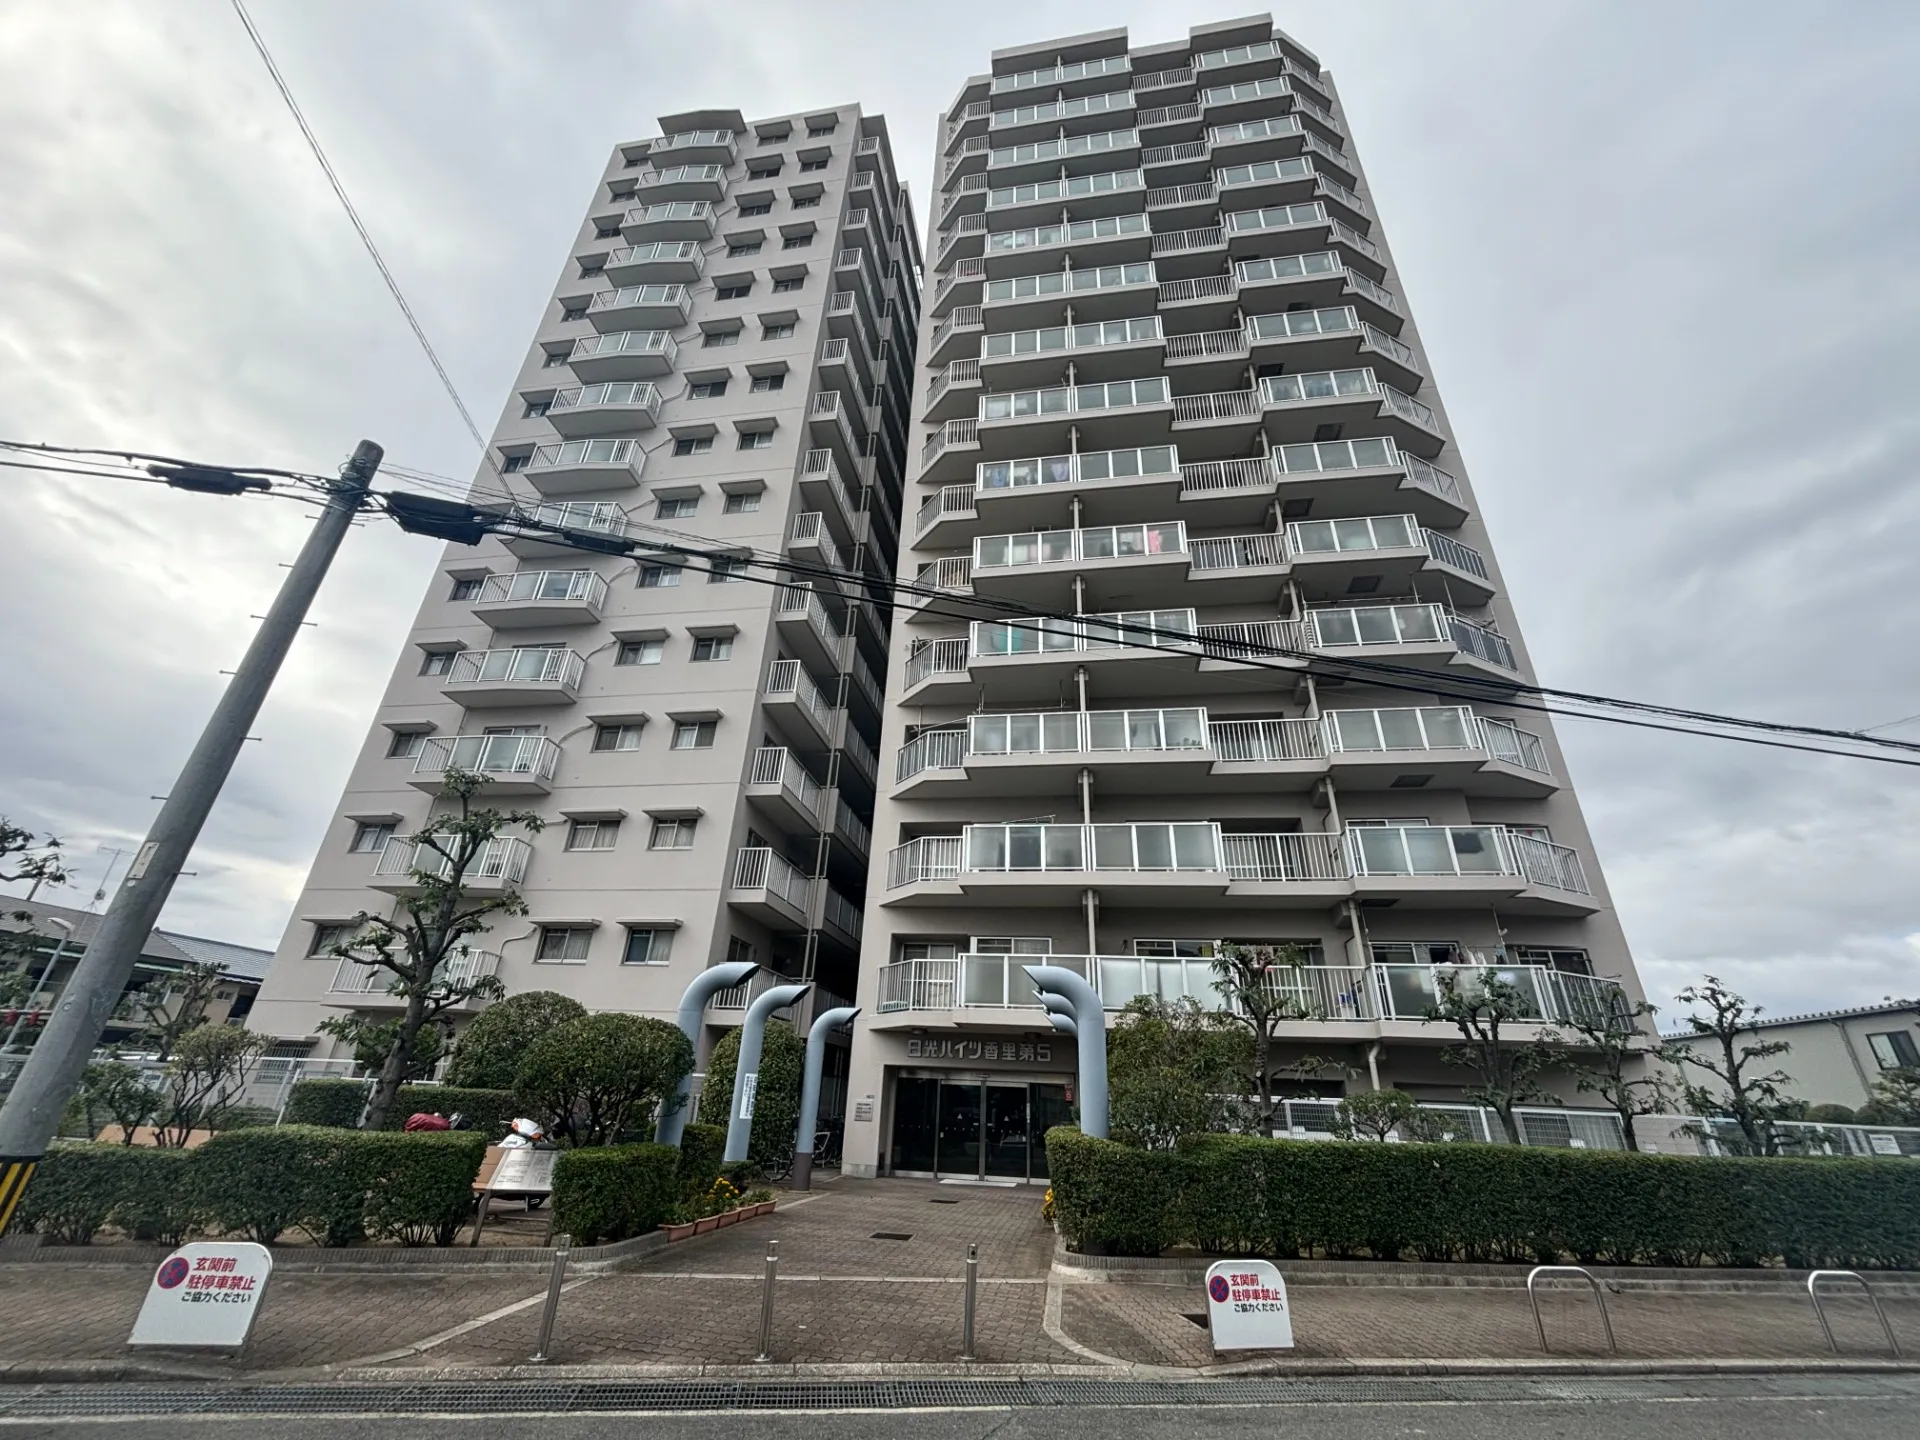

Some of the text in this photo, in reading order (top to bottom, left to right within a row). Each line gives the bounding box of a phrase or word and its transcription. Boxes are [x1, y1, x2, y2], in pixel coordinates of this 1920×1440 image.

[908, 1039, 1051, 1062] 日光ハイツ香里第5
[193, 1257, 237, 1272] 玄関前
[186, 1275, 256, 1290] 駐停車禁止
[1230, 1274, 1259, 1286] 玄関前
[181, 1291, 252, 1303] ご協力ください
[1232, 1288, 1281, 1301] 駐停車禁止
[1234, 1303, 1283, 1312] ご協力ください
